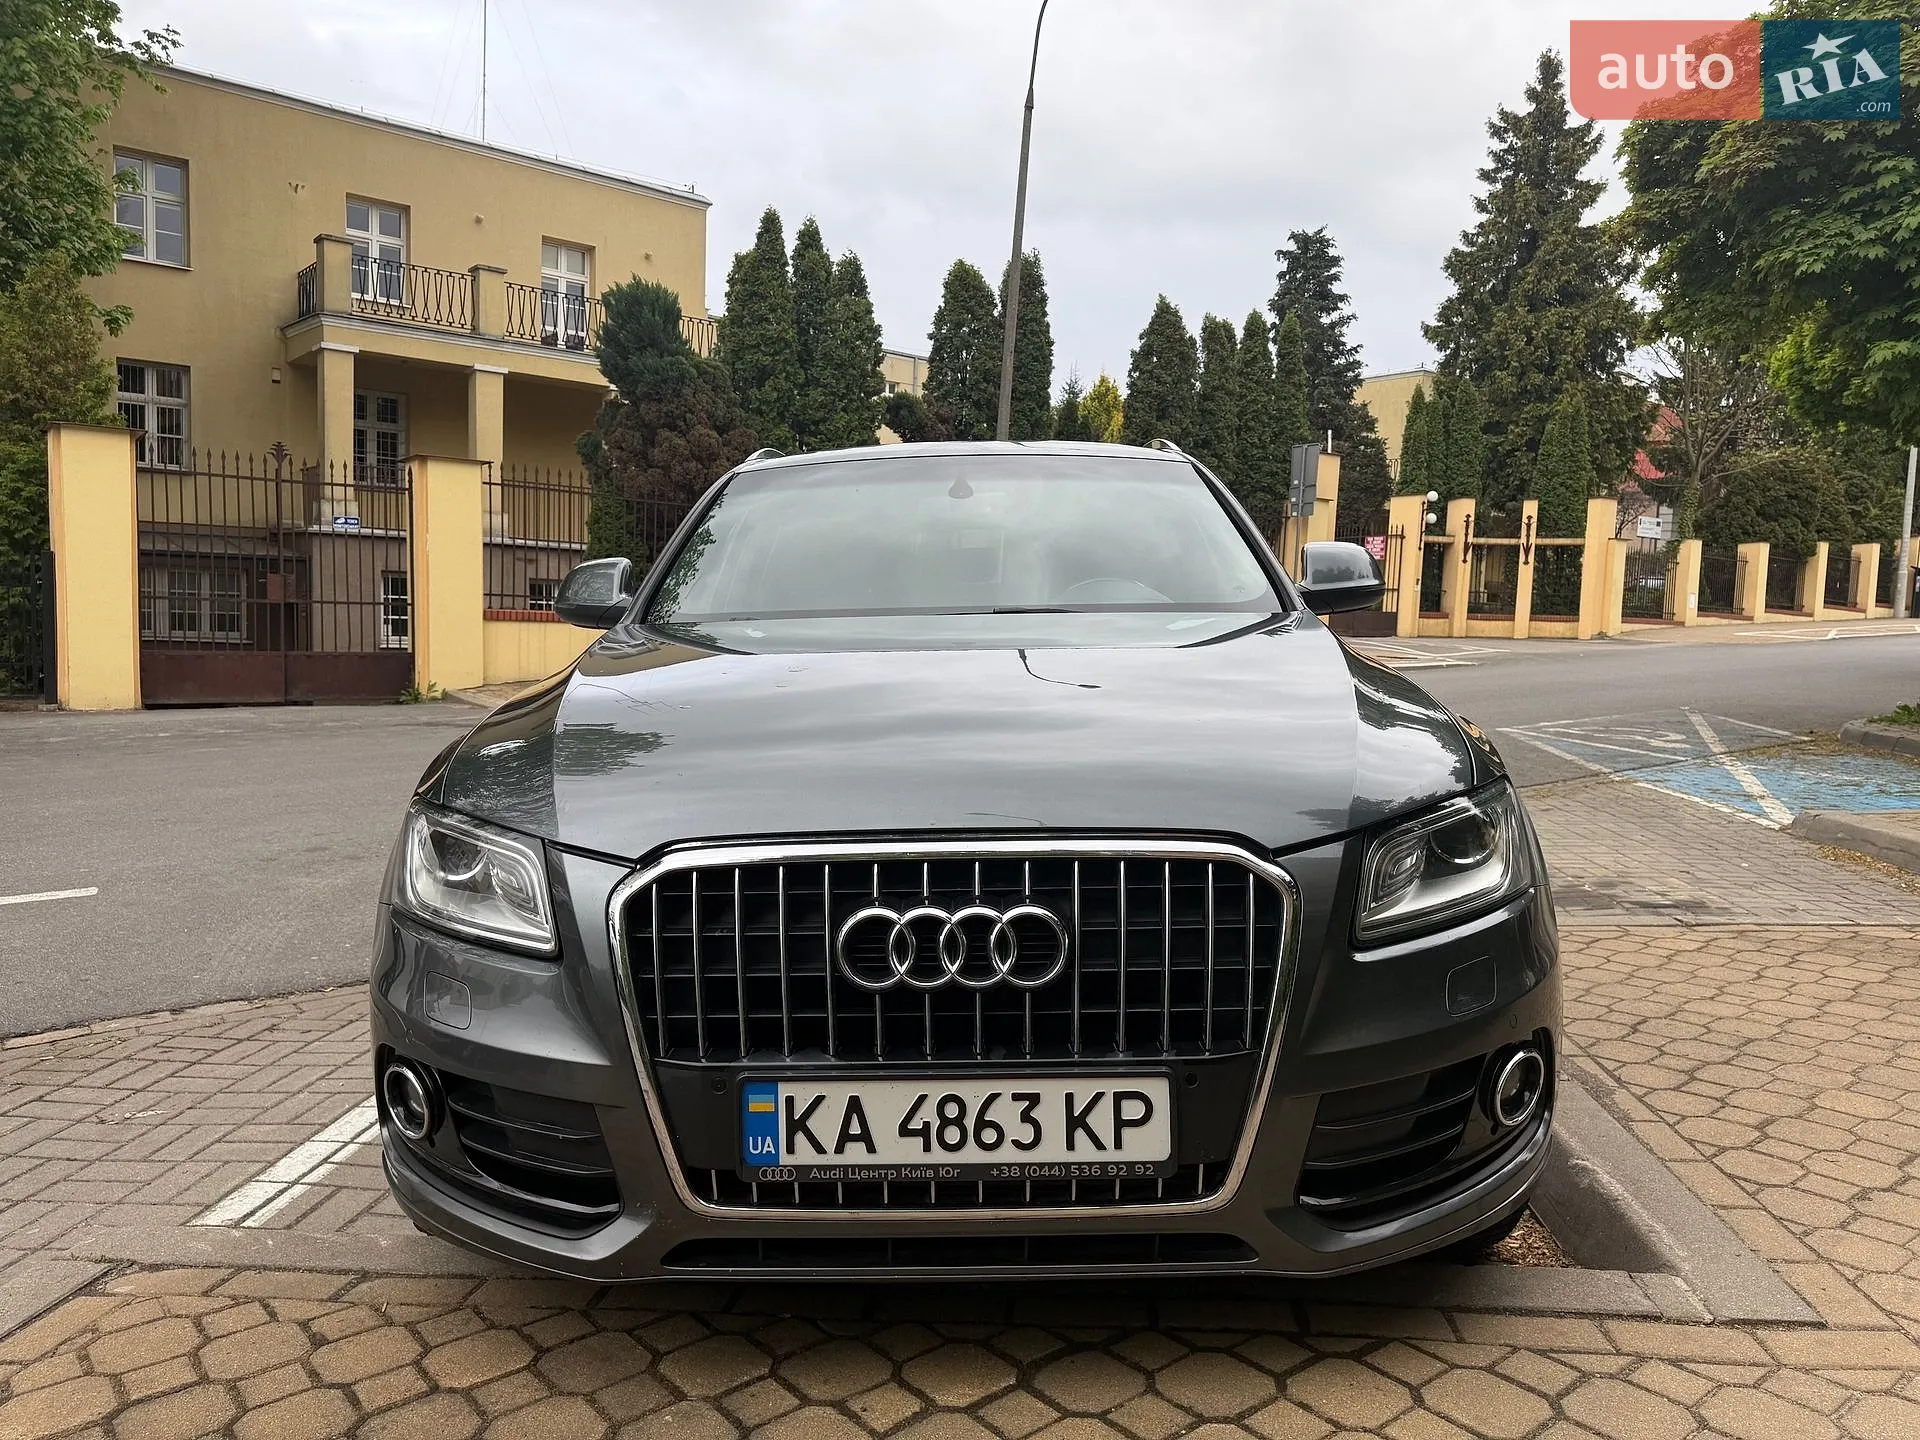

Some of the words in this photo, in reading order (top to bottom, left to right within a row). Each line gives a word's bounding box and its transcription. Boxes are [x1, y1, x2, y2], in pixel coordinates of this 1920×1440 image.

[784, 1094, 877, 1155] KA
[898, 1092, 1043, 1153] 4863
[1064, 1090, 1155, 1151] KP
[748, 1136, 776, 1154] UA
[809, 1167, 844, 1179] Audi
[848, 1168, 897, 1181] Центр
[901, 1167, 935, 1178] Київ
[939, 1167, 961, 1178] Юг
[990, 1166, 1021, 1177] +38
[1024, 1165, 1066, 1178] (044)
[1070, 1165, 1101, 1176] 536
[1107, 1165, 1128, 1176] 92
[1135, 1164, 1155, 1175] 92
